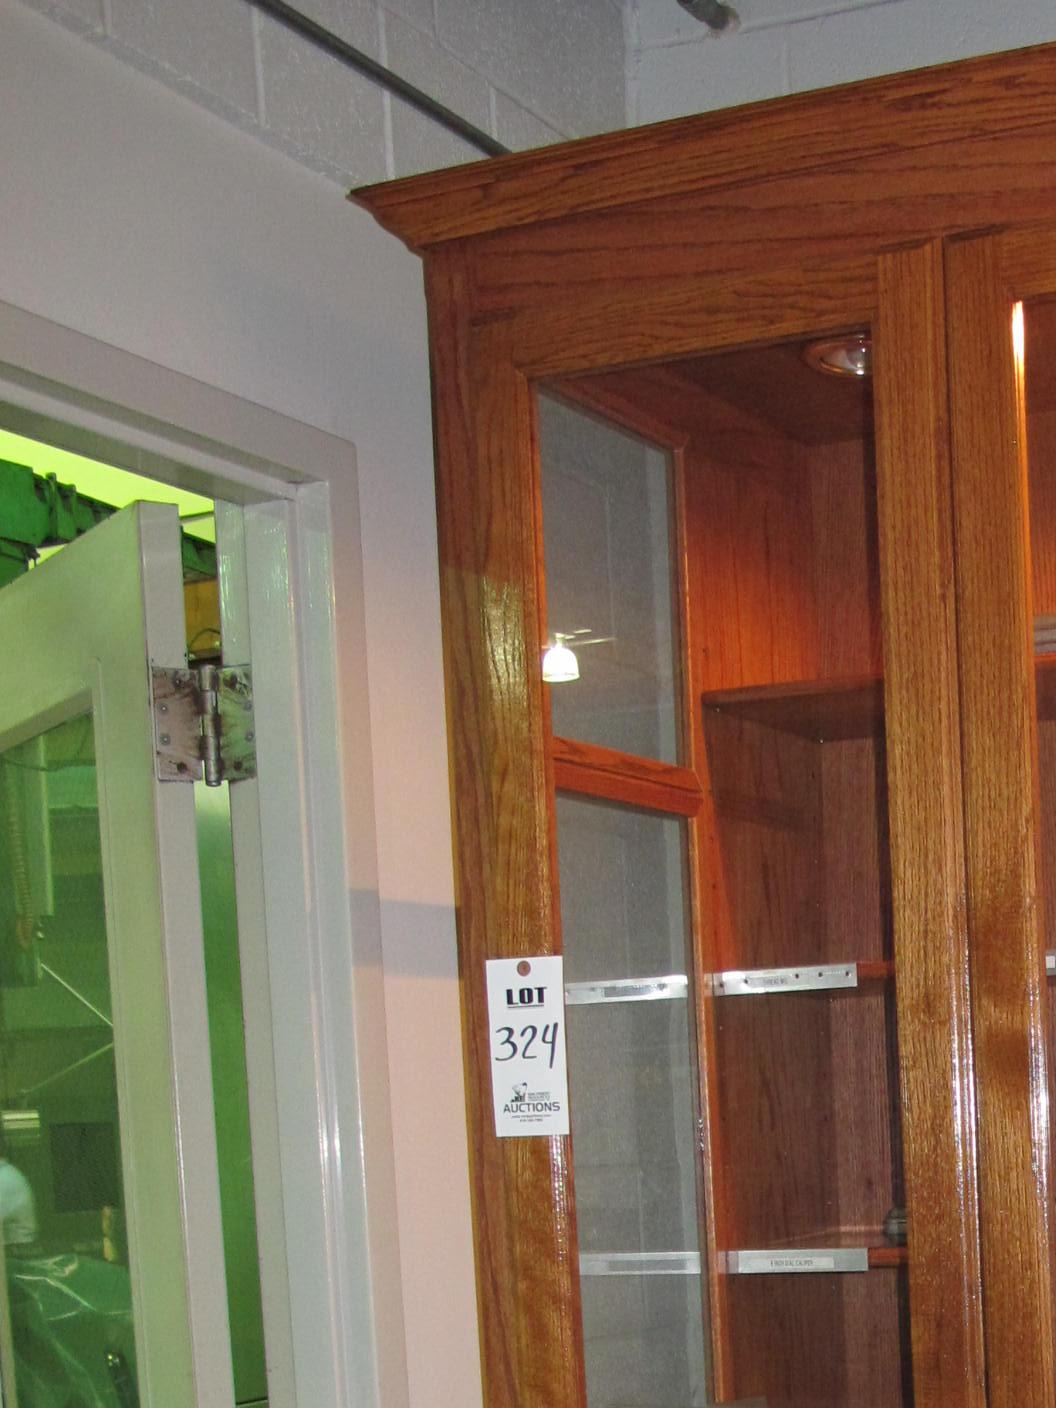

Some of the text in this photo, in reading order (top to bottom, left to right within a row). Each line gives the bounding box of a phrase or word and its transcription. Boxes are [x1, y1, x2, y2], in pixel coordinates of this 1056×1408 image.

[506, 986, 548, 1006] LOT
[494, 1022, 559, 1069] 324
[503, 1101, 561, 1113] AUCTIONS
